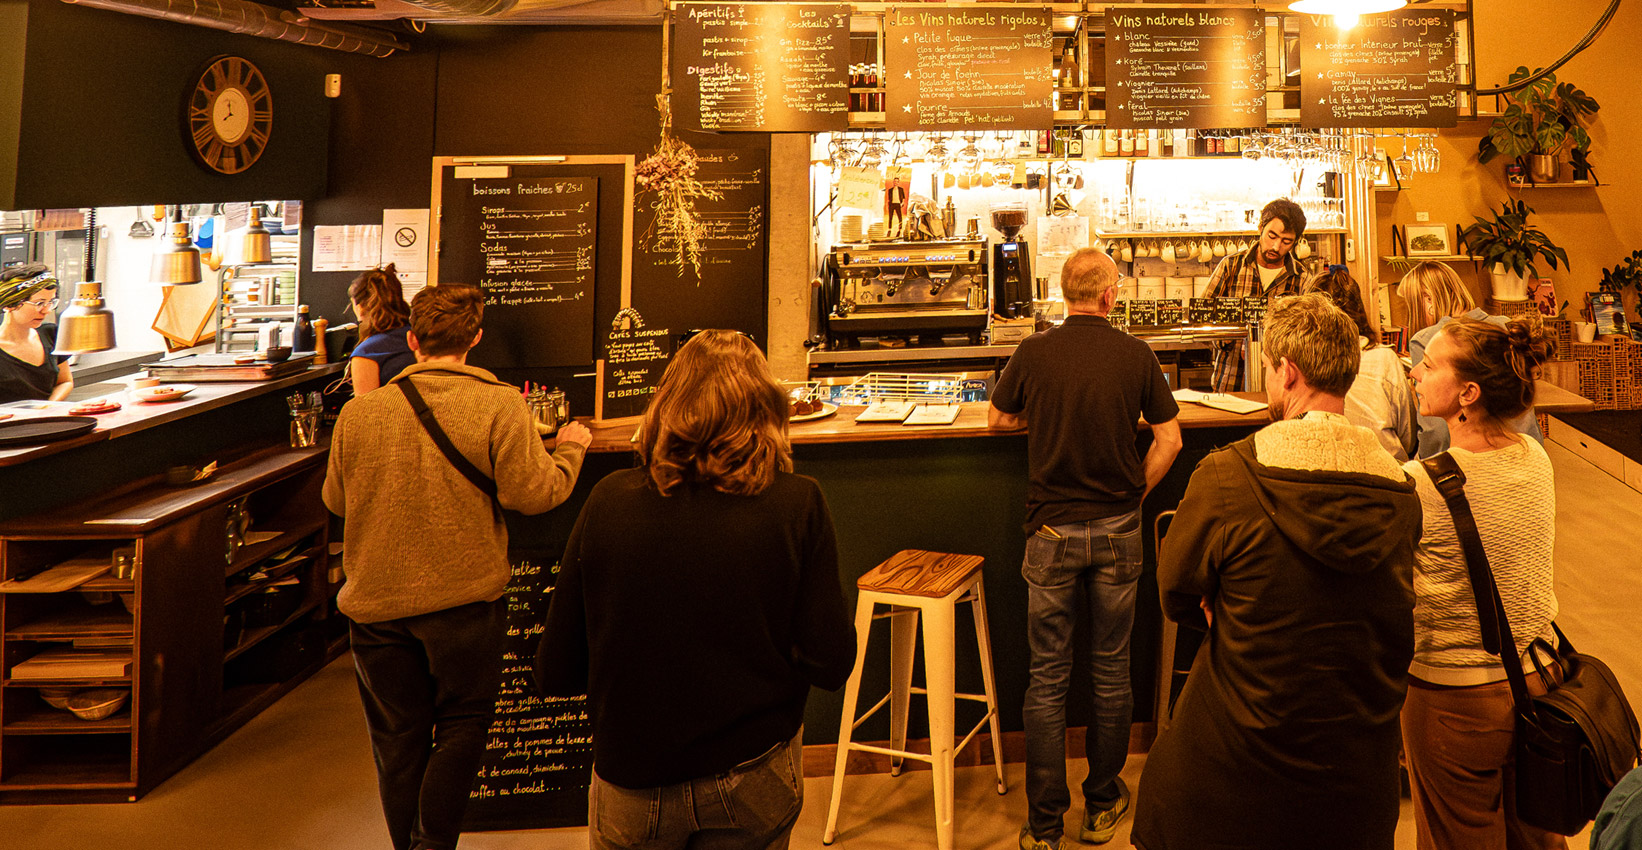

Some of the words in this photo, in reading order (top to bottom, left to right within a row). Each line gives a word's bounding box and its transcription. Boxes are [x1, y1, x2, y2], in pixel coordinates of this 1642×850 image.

[689, 6, 735, 23] Apéritifs
[800, 9, 816, 18] Les
[787, 17, 830, 28] Cocktails
[896, 10, 916, 27] Les
[919, 12, 945, 27] Vins
[947, 11, 996, 26] naturels
[1000, 11, 1039, 31] rigolos
[1113, 14, 1142, 28] Vins
[1146, 12, 1196, 27] naturels
[1199, 12, 1235, 26] blancs
[1402, 16, 1441, 36] rouges
[914, 30, 941, 44] Petite
[1124, 31, 1151, 41] blanc
[1324, 38, 1356, 50] bonheur
[1402, 36, 1423, 49] brut
[687, 62, 735, 77] Digestifs
[914, 68, 937, 80] Jour
[940, 69, 951, 80] de
[1326, 69, 1357, 82] Gamay
[1125, 80, 1155, 89] Viognier
[1353, 93, 1367, 104] des
[1369, 93, 1396, 107] Vignes
[473, 183, 511, 195] boissons
[481, 206, 505, 216] Sirops
[480, 222, 496, 231] Jus
[480, 241, 508, 253] Sodas
[480, 279, 509, 288] Infusion
[483, 294, 498, 306] afé
[634, 328, 669, 338] SUSPENDUS
[506, 625, 520, 636] des
[513, 737, 523, 749] de
[524, 738, 553, 752] pommes
[490, 765, 500, 777] de
